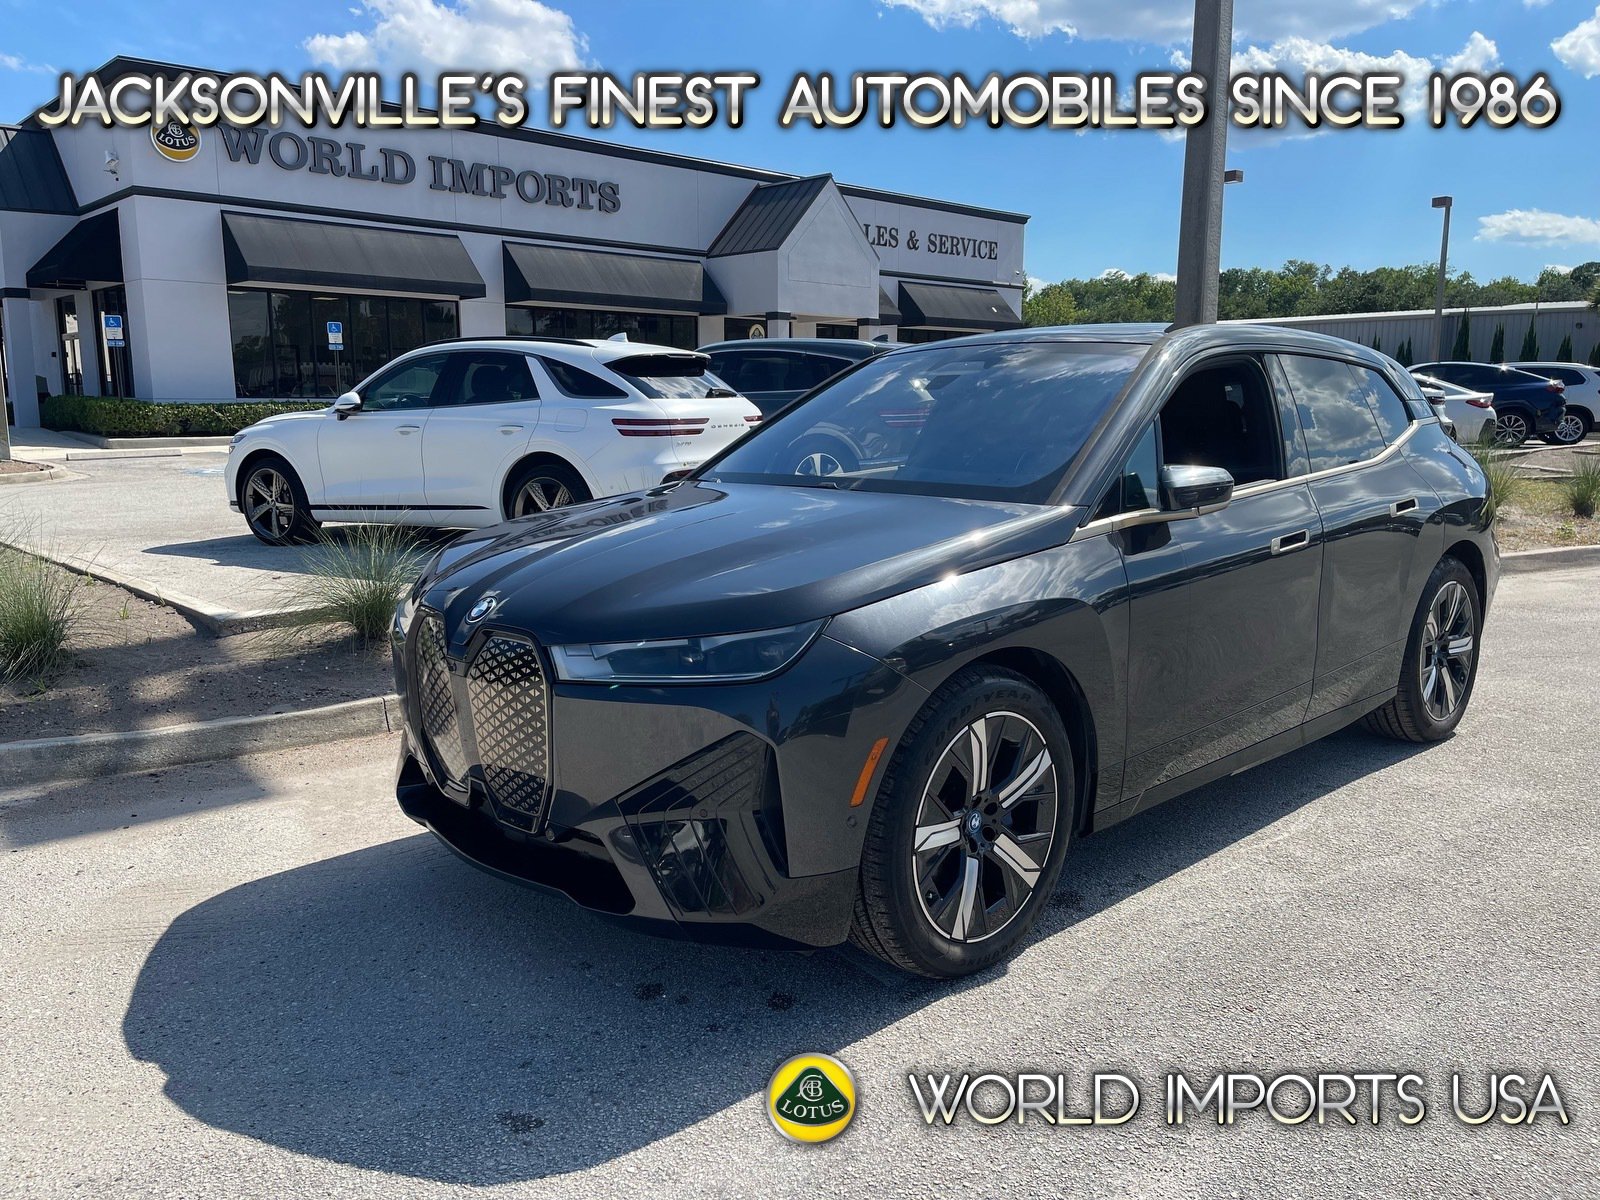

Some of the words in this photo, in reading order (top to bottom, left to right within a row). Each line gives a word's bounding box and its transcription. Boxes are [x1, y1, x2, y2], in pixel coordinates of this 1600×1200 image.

[158, 133, 196, 147] LOTUS
[216, 122, 416, 185] WORLD
[428, 155, 622, 213] IMPORTS
[906, 229, 920, 251] &
[927, 232, 999, 261] SERVICE
